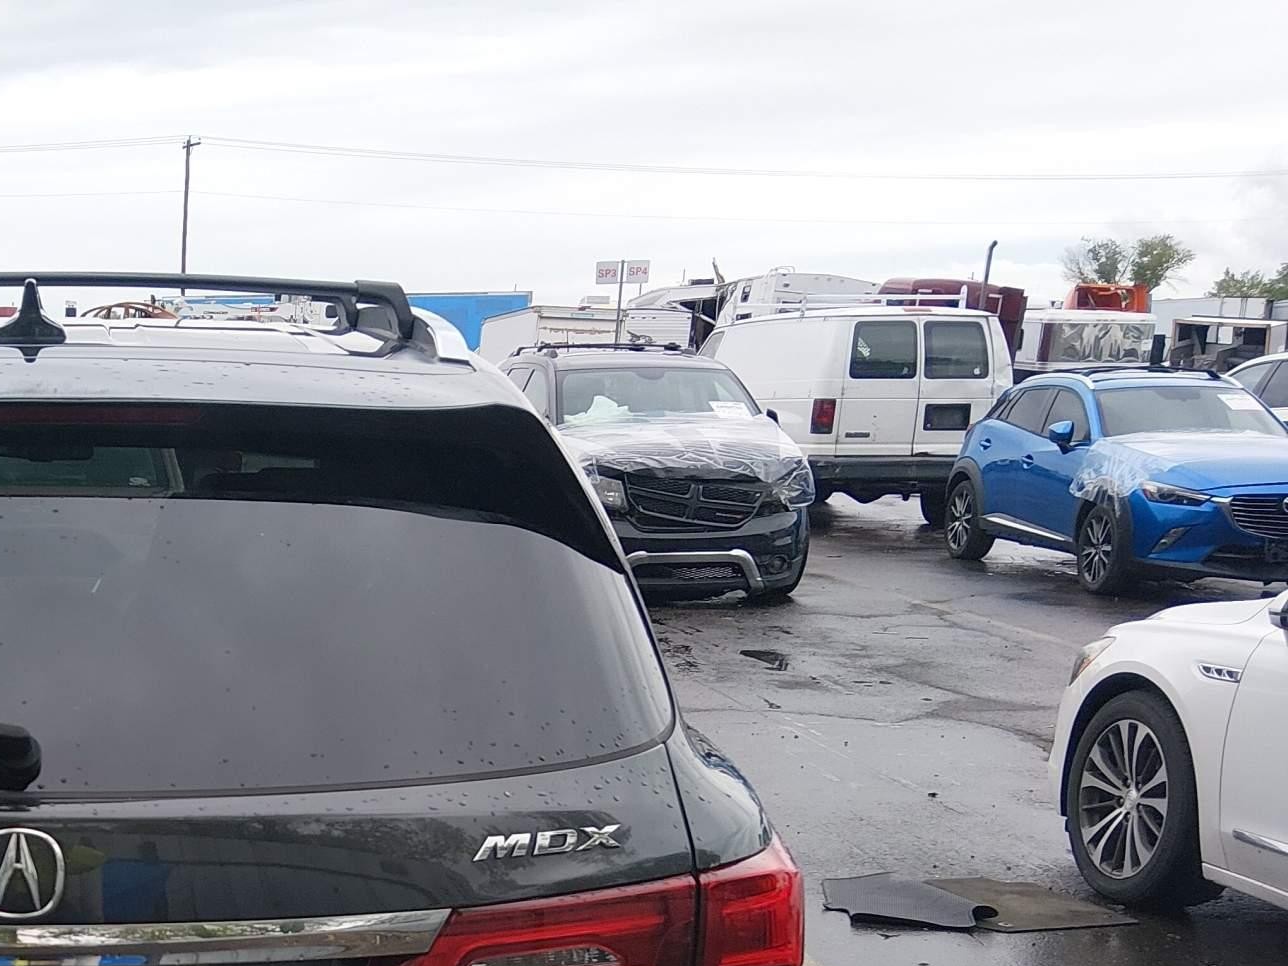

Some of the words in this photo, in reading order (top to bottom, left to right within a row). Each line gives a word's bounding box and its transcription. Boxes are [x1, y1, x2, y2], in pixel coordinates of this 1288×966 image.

[598, 268, 617, 278] SP3
[628, 266, 648, 276] SP4
[473, 824, 622, 862] MDX
